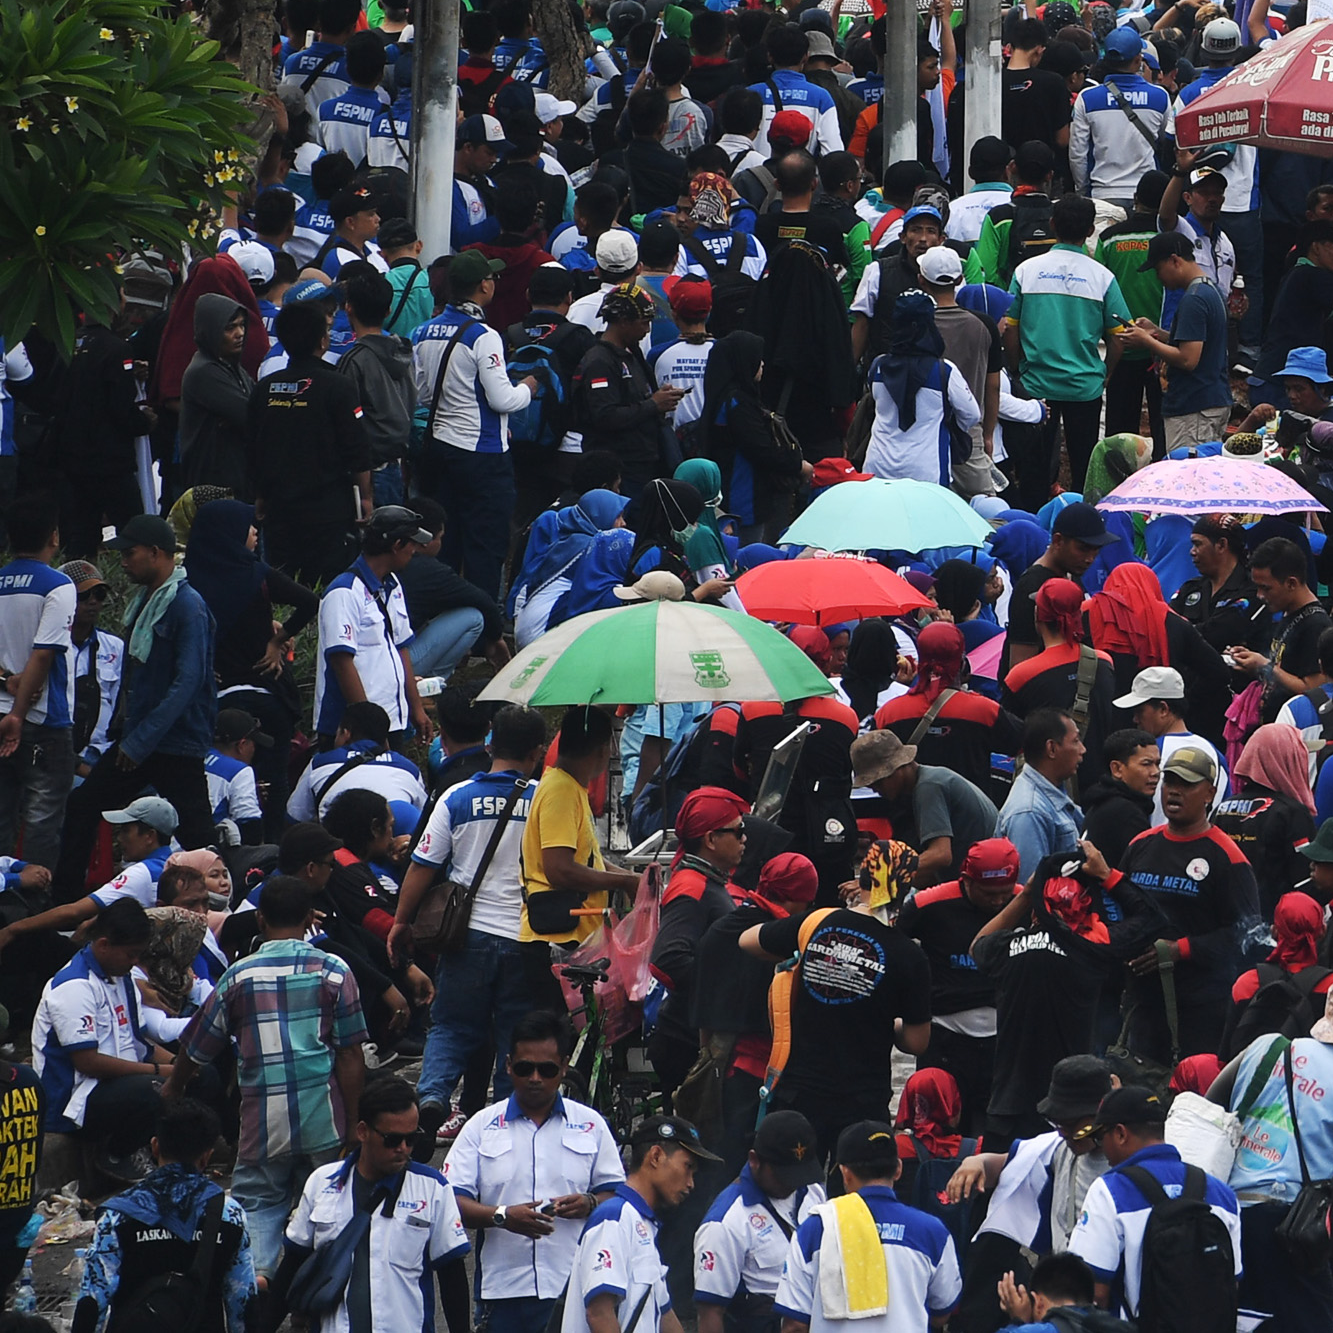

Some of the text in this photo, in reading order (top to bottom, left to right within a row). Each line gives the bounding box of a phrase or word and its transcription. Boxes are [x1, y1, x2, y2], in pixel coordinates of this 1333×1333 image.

[334, 102, 376, 122] FSPMI
[1198, 108, 1249, 128] Rasa Teh Terbaik
[1302, 109, 1330, 124] Rasa
[1199, 122, 1250, 142] ada di Pucuknya!
[1300, 124, 1322, 137] ada
[1162, 875, 1200, 894] METAL
[1253, 1126, 1270, 1143] Le
